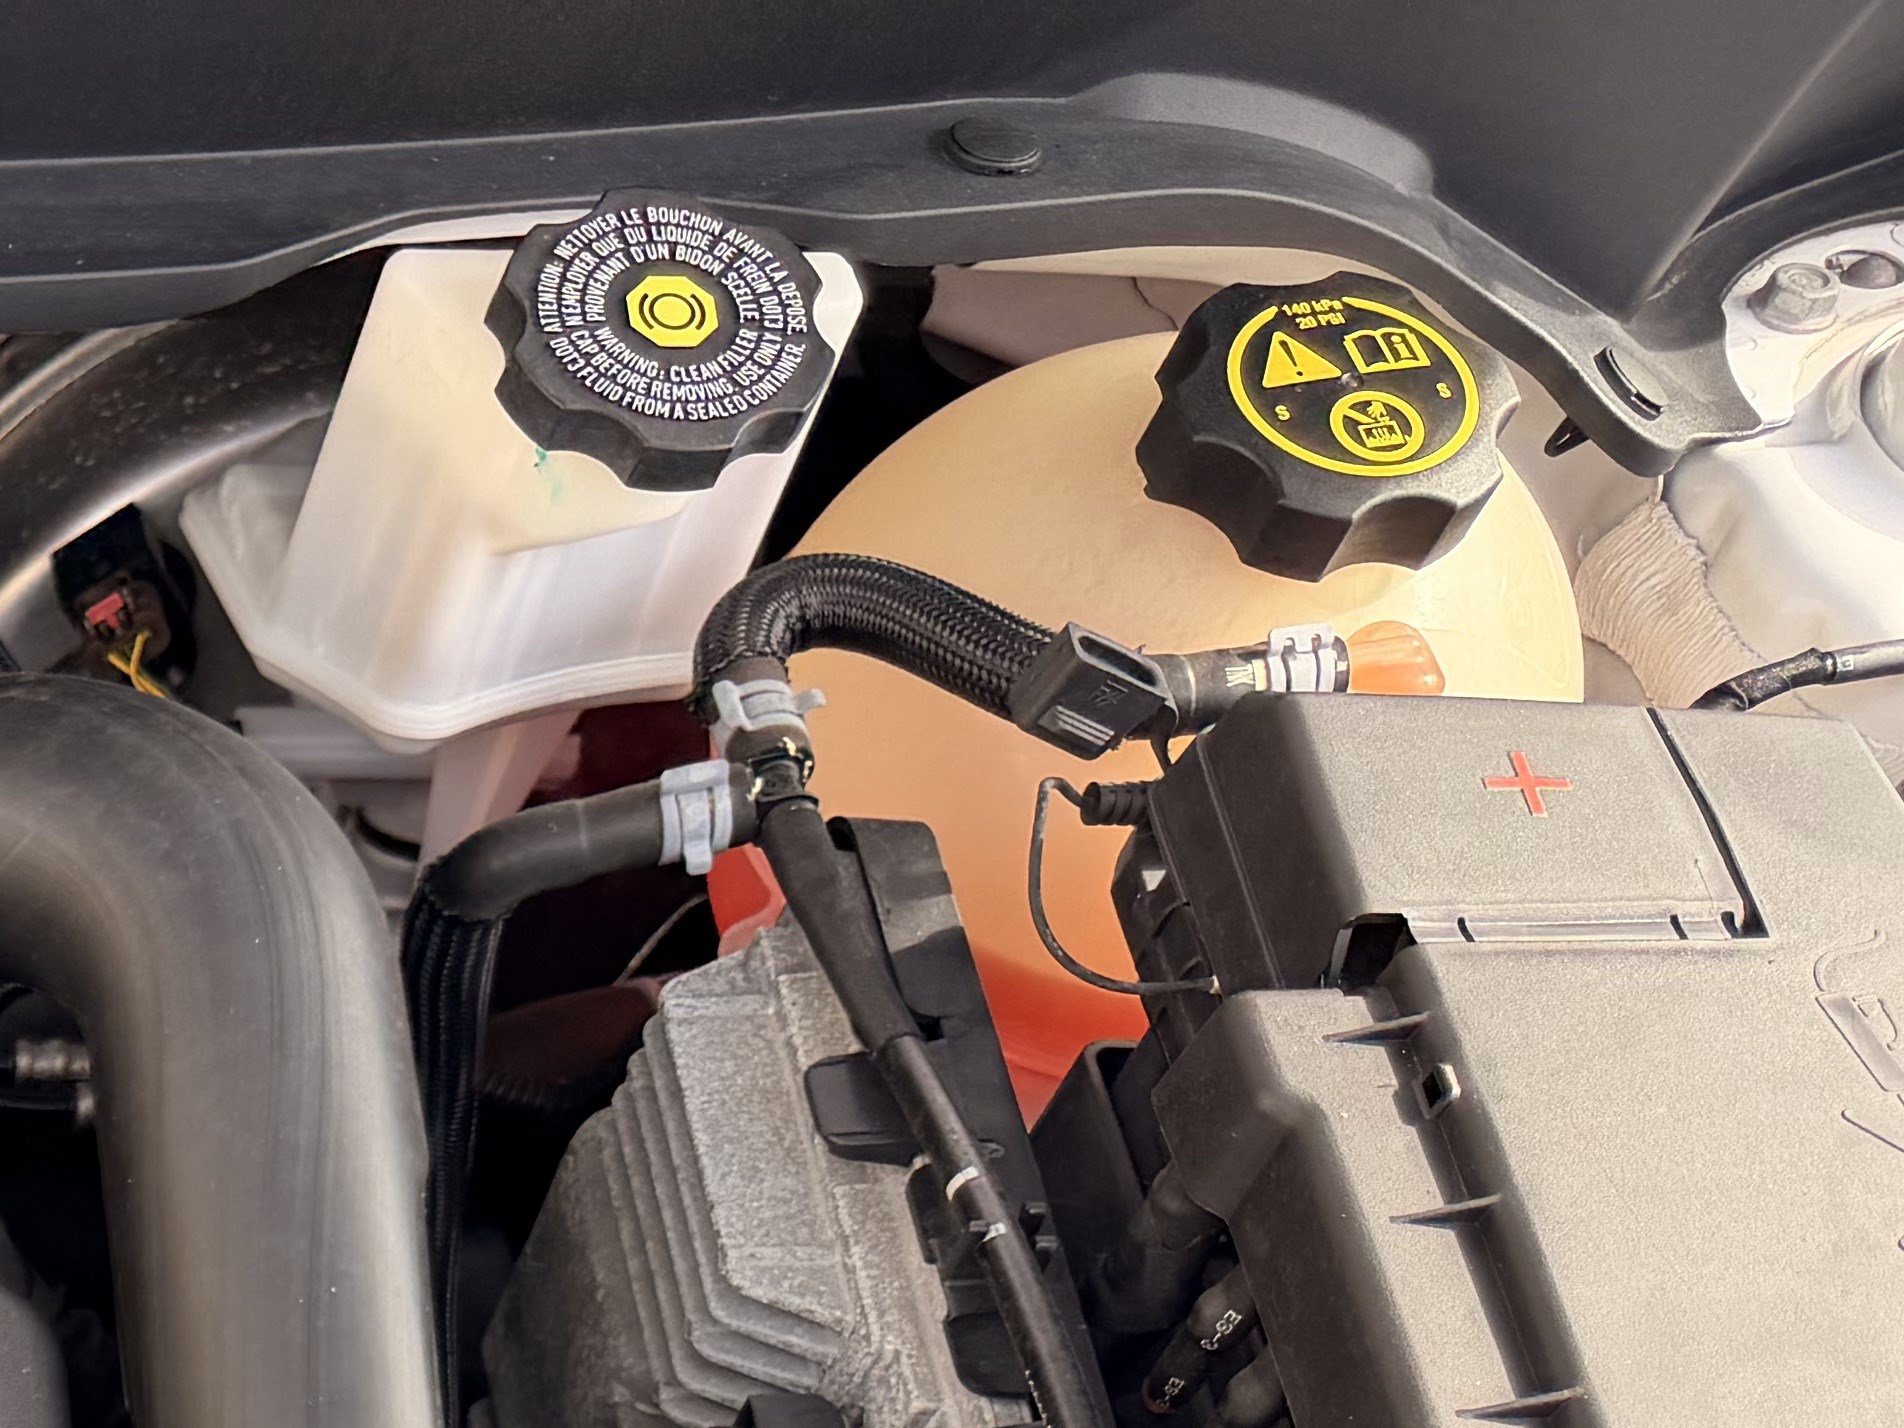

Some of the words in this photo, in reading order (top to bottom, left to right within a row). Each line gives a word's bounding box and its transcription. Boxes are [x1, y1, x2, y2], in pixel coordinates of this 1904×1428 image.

[537, 260, 565, 332] ATTENTION:
[554, 213, 622, 260] NETTOYER
[621, 208, 640, 224] LE
[647, 206, 722, 236] BOUCHON
[725, 229, 772, 263] AVANT
[766, 260, 787, 281] LA
[585, 254, 631, 323] PROVENANT
[630, 243, 671, 263] D'UN
[675, 246, 725, 277] BIDON
[592, 235, 626, 257] QUE
[624, 226, 646, 244] DU
[652, 226, 714, 250] LIQUIDE
[715, 242, 738, 263] DE
[732, 256, 772, 297] FREIN
[761, 295, 784, 331] DOT3
[1281, 301, 1311, 317] 140
[1296, 317, 1317, 329] 20
[1318, 313, 1347, 327] PSI
[549, 337, 580, 372] DOT3
[577, 366, 623, 403] FLUID
[622, 392, 670, 419] FROM
[673, 402, 685, 420] A
[687, 397, 749, 421] SEALED
[570, 329, 597, 356] CAP
[592, 352, 649, 394] BEFORE
[733, 360, 766, 387] USE
[759, 331, 783, 370] ONLY
[669, 358, 724, 383] CLEAN
[722, 328, 758, 373] FILLER
